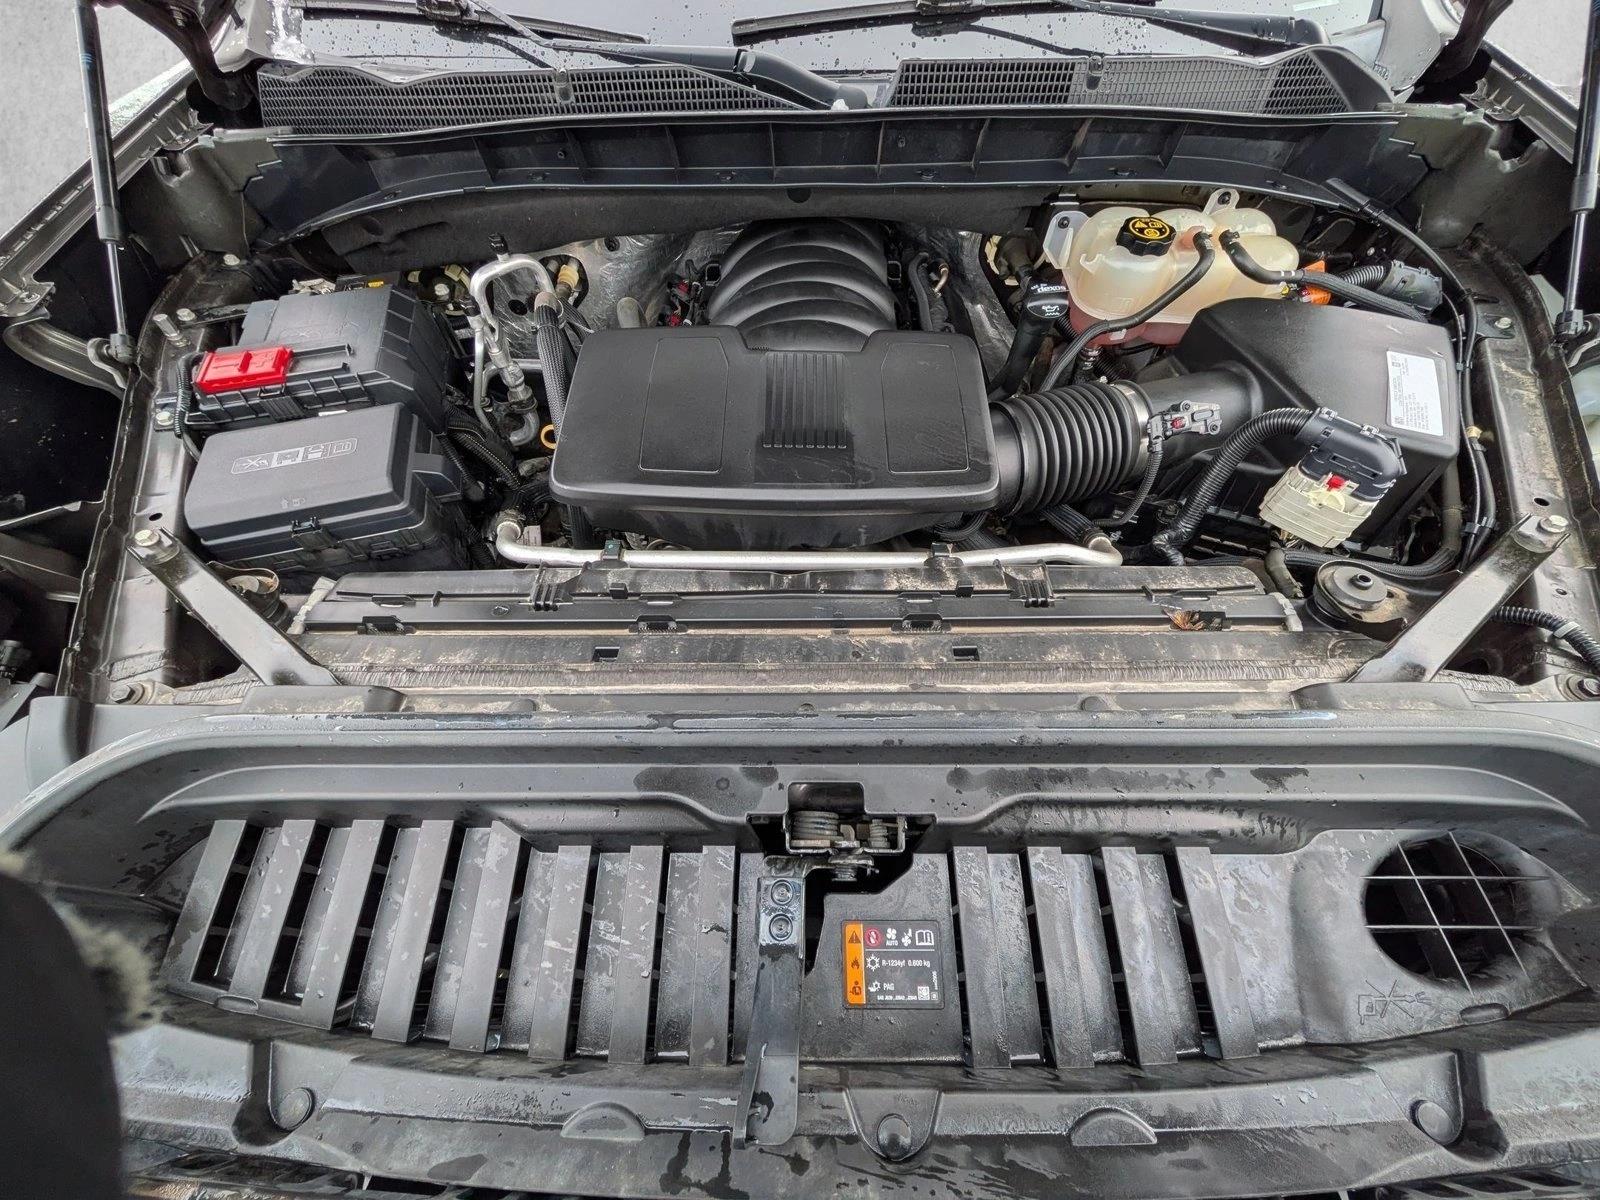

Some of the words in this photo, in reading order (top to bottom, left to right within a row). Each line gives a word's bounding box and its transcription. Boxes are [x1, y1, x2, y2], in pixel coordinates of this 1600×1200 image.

[1037, 285, 1067, 293] dexos
[881, 959, 906, 968] R-1234yf
[923, 959, 931, 968] kg
[883, 983, 895, 991] PAG
